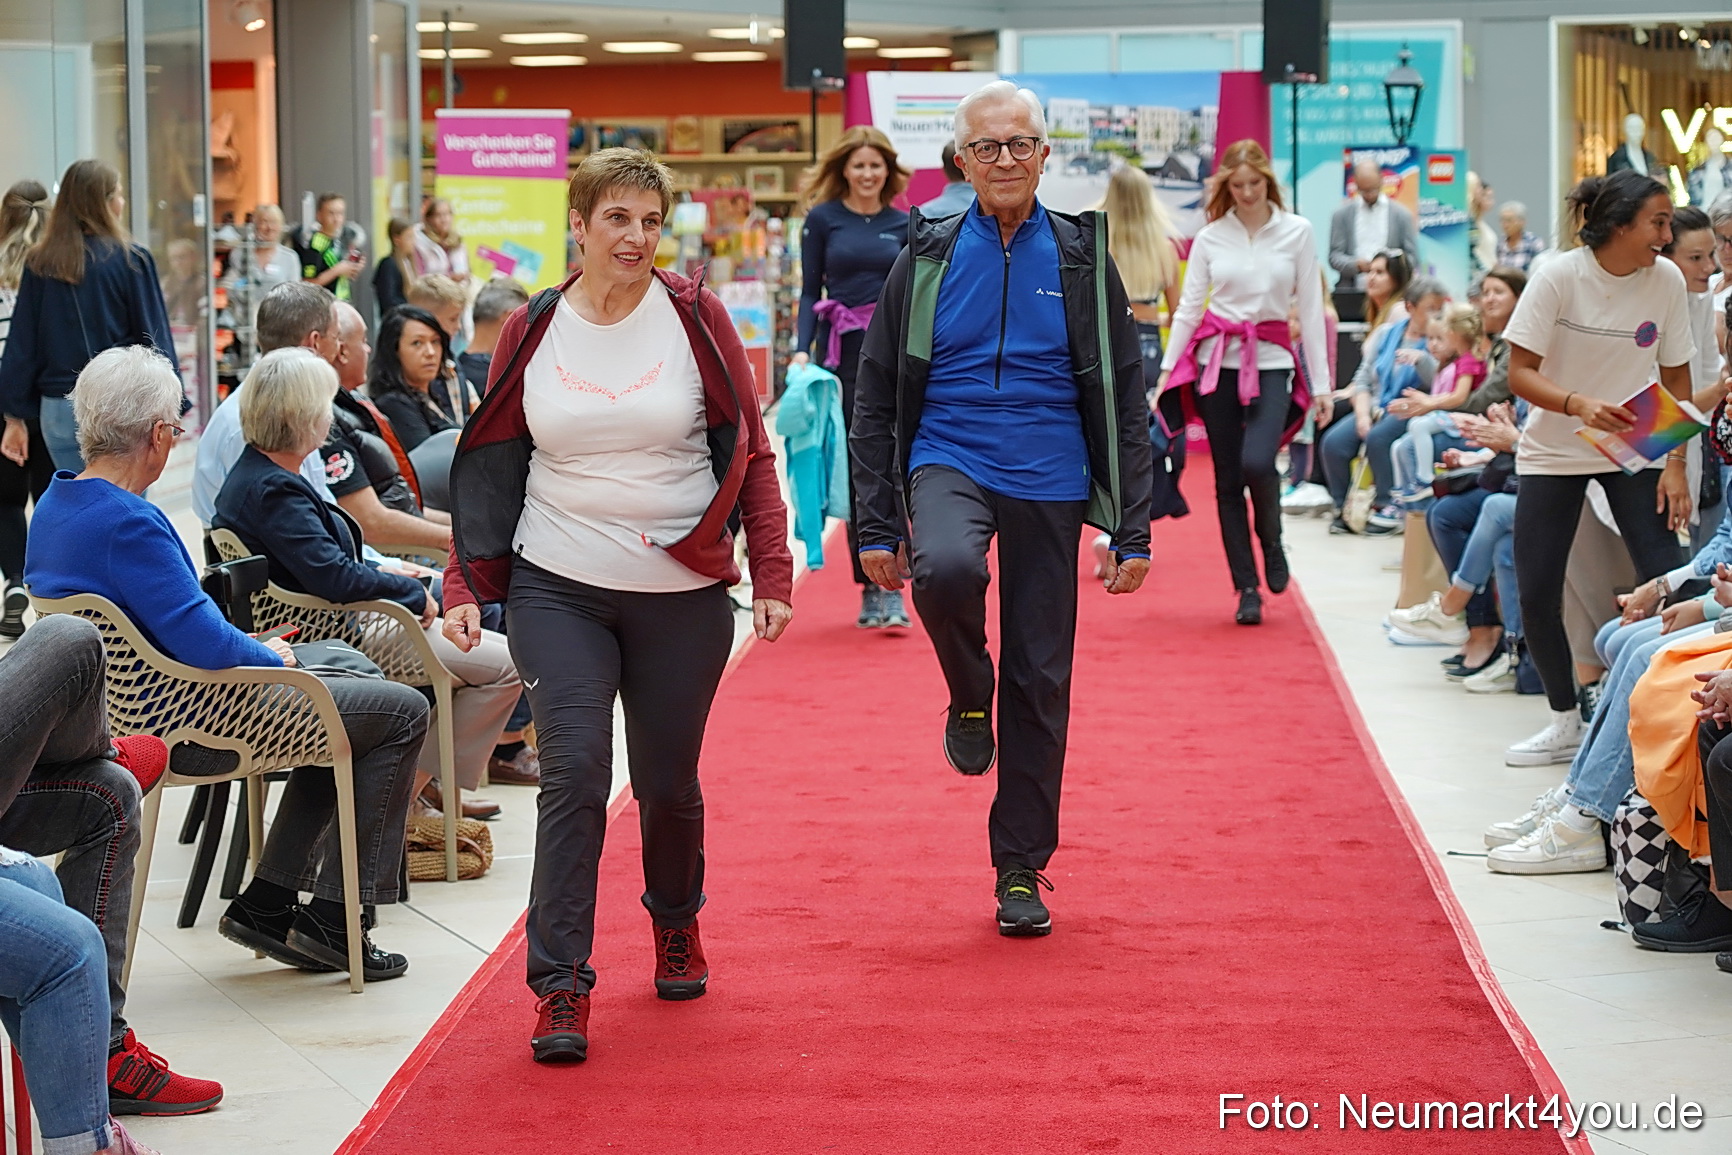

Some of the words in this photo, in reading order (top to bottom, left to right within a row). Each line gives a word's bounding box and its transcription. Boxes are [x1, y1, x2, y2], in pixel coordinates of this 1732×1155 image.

[443, 133, 532, 151] Verschenken
[533, 133, 557, 151] Sie
[471, 149, 557, 169] Gutscheine!
